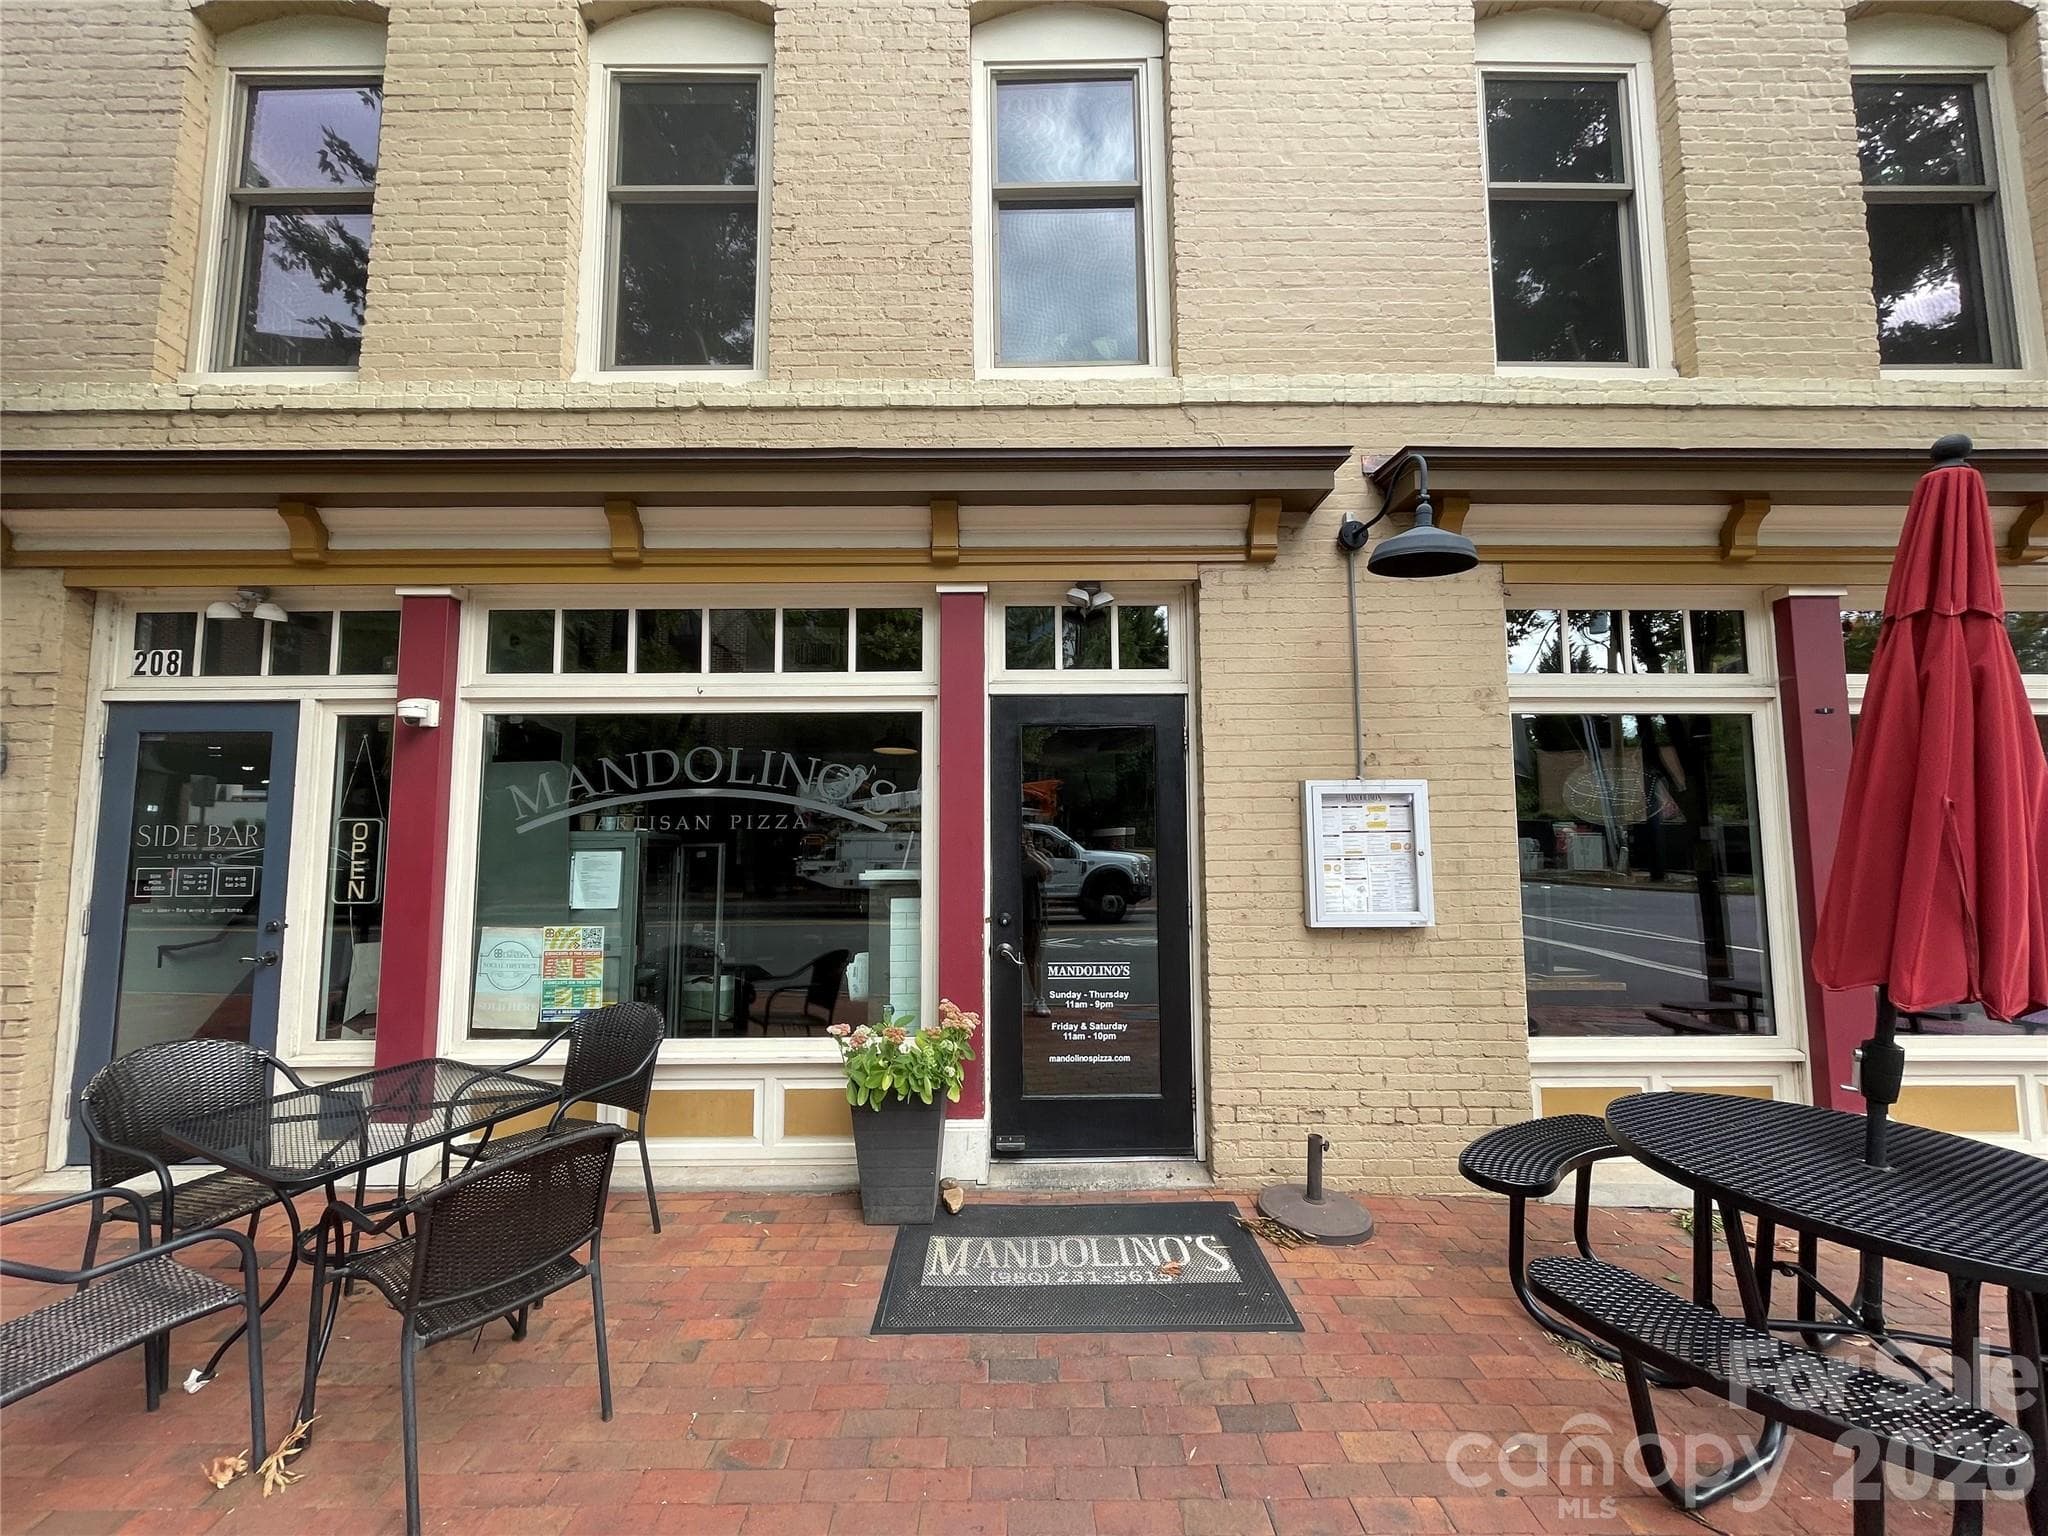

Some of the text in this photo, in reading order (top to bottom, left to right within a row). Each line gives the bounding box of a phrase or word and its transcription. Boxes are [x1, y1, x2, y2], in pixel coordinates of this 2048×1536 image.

[134, 650, 181, 676] 208
[506, 746, 897, 821] MANDOLINO'S
[730, 814, 808, 831] PIZZA
[136, 824, 259, 847] SIDE BAR
[347, 822, 369, 900] OPEN
[1047, 965, 1130, 977] MANDOLINO'S
[1049, 990, 1082, 1000] Sunday
[1089, 990, 1130, 1000] Thursday
[1065, 1000, 1088, 1008] 11am
[1094, 1000, 1114, 1010] 9pm
[1051, 1022, 1128, 1032] Friday & Saturday
[1063, 1032, 1086, 1041] 11am
[1092, 1032, 1117, 1042] 10pm
[1048, 1053, 1131, 1064] mandolinospizza.com
[928, 1235, 1231, 1276] MANDOLINO'S
